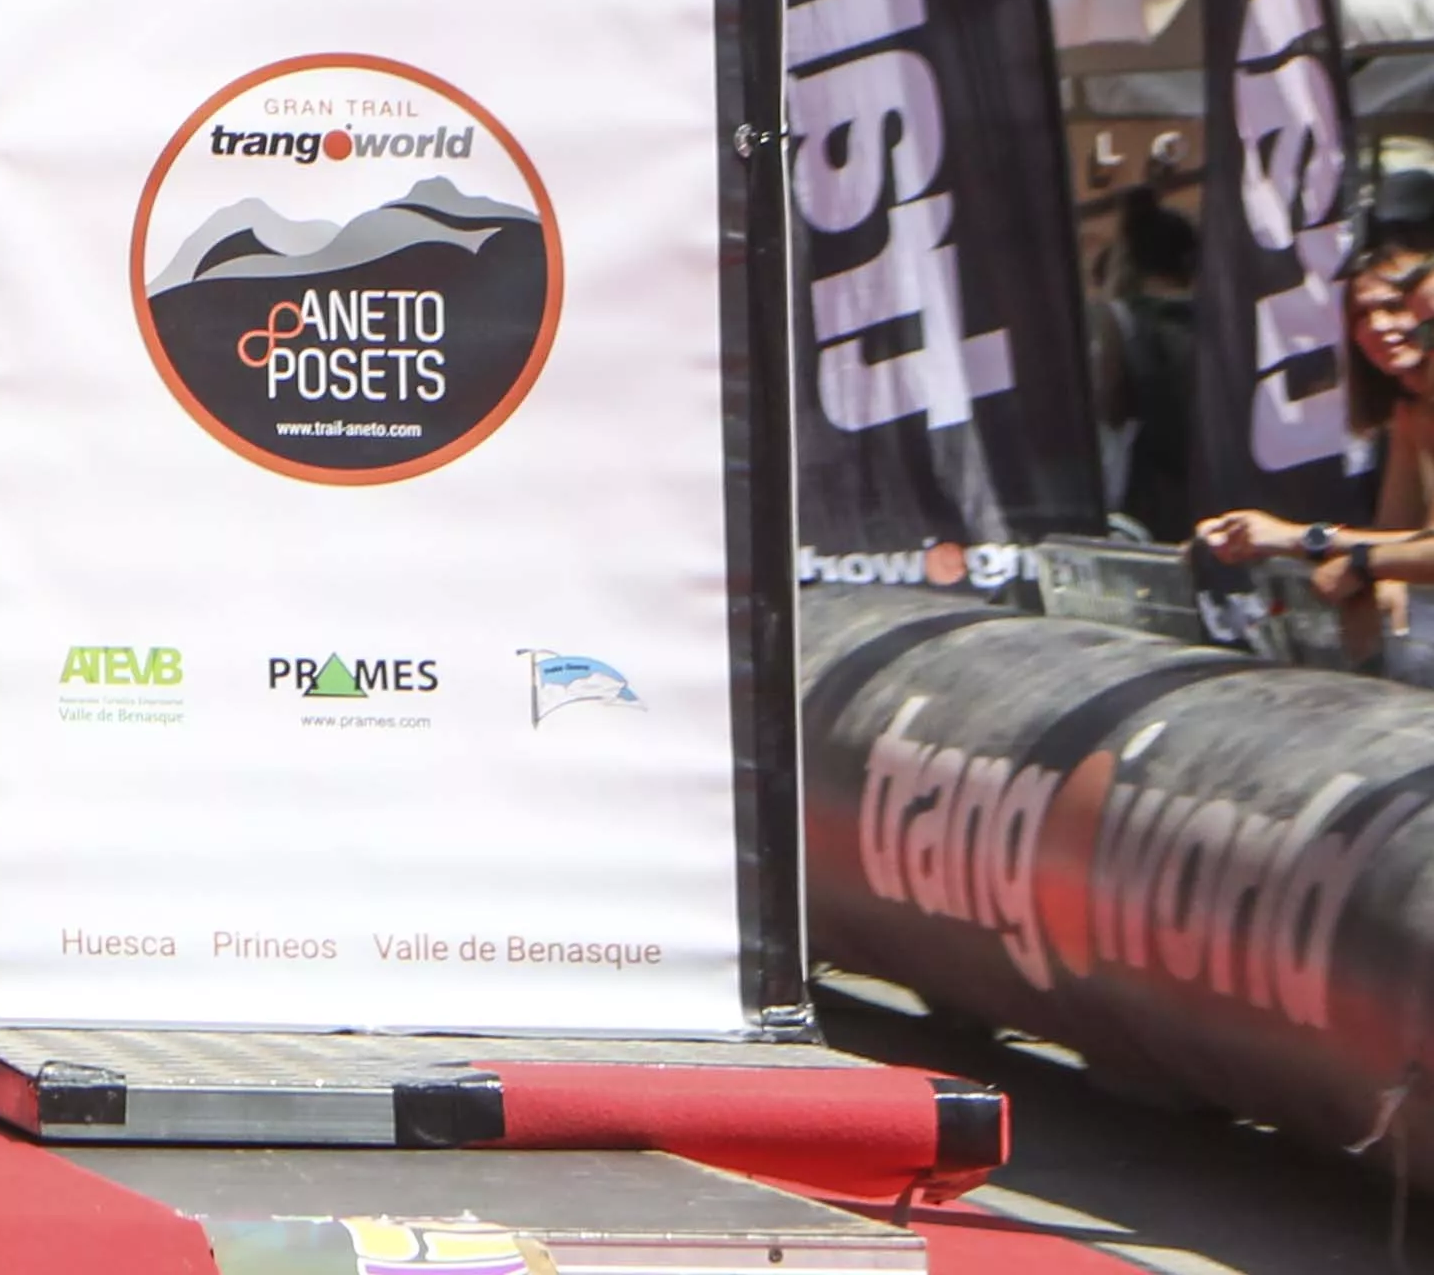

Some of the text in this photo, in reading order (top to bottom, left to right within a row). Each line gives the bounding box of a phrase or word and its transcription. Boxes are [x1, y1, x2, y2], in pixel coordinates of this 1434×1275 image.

[264, 97, 420, 118] GRAN TRAIL
[301, 289, 446, 344] ANETO
[267, 347, 447, 402] POSETS
[275, 420, 423, 439] www.trail-aneto.com
[58, 707, 185, 728] Valle de Benasque
[300, 714, 431, 730] www.prames.com
[60, 927, 663, 971] Huesca Pirineos Valle de Benasque
